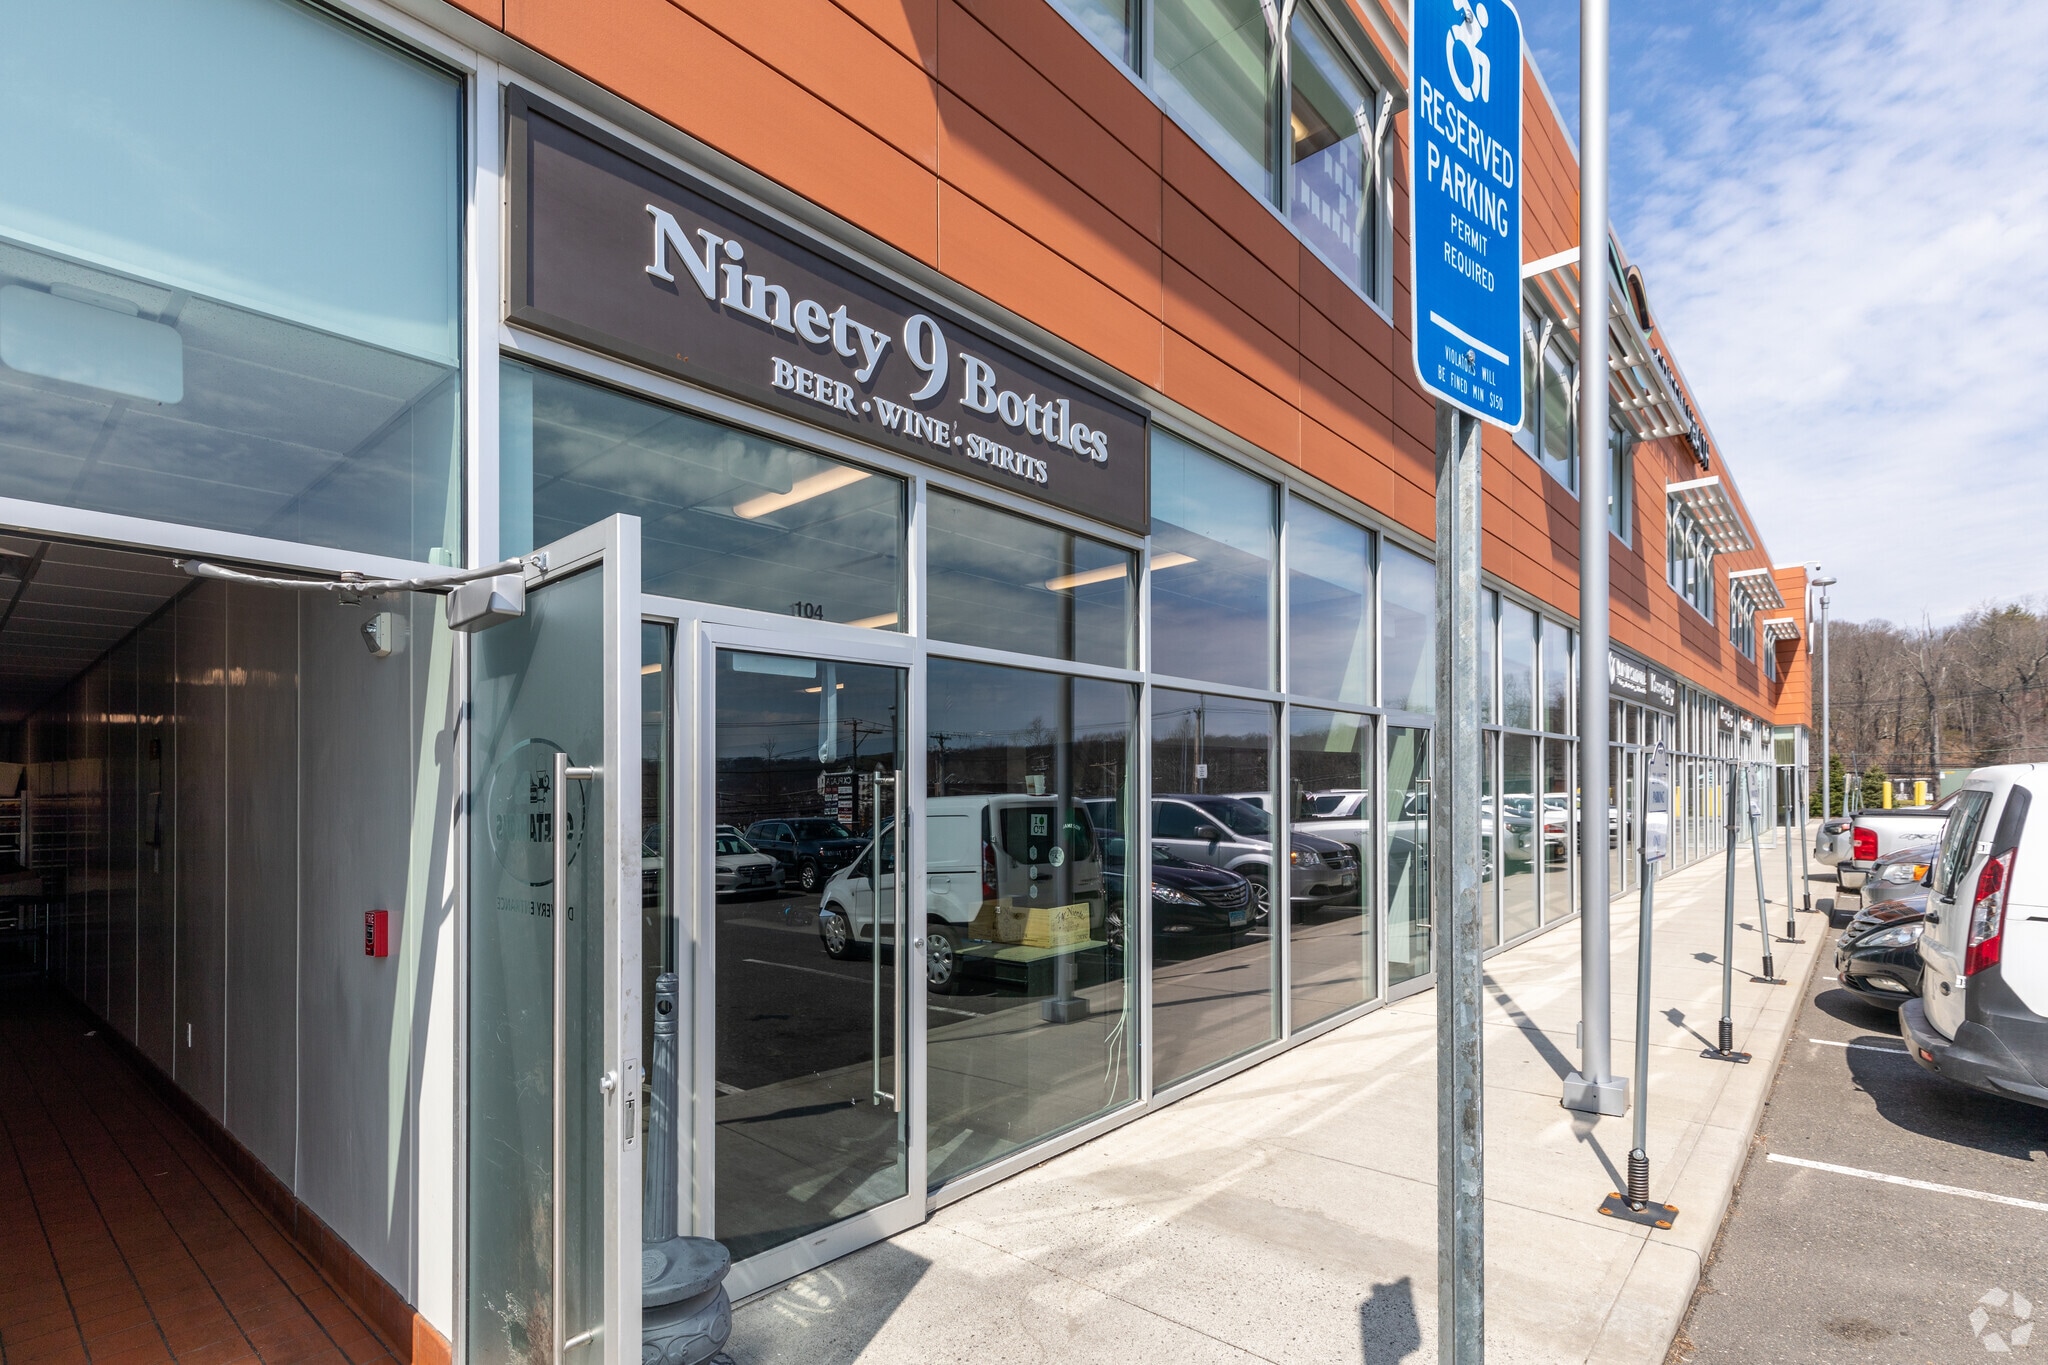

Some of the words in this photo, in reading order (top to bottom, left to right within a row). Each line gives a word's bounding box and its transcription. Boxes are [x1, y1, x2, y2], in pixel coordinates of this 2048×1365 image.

[1420, 75, 1514, 190] RESERVED
[1427, 139, 1508, 238] PARKING
[1450, 212, 1488, 257] PERMIT
[1444, 240, 1495, 292] REQUIRED
[645, 203, 892, 384] Ninety
[903, 313, 949, 401] 9
[959, 352, 1109, 463] Bottles
[1438, 364, 1446, 382] BE
[1450, 371, 1468, 395] FINED
[1472, 384, 1485, 403] MIN
[1489, 391, 1504, 412] $150
[1482, 366, 1496, 386] WILL
[770, 356, 859, 416] BEER
[872, 396, 950, 448] WINE
[966, 433, 1049, 484] SPIRITS
[794, 600, 824, 621] 104
[1032, 825, 1045, 835] CT
